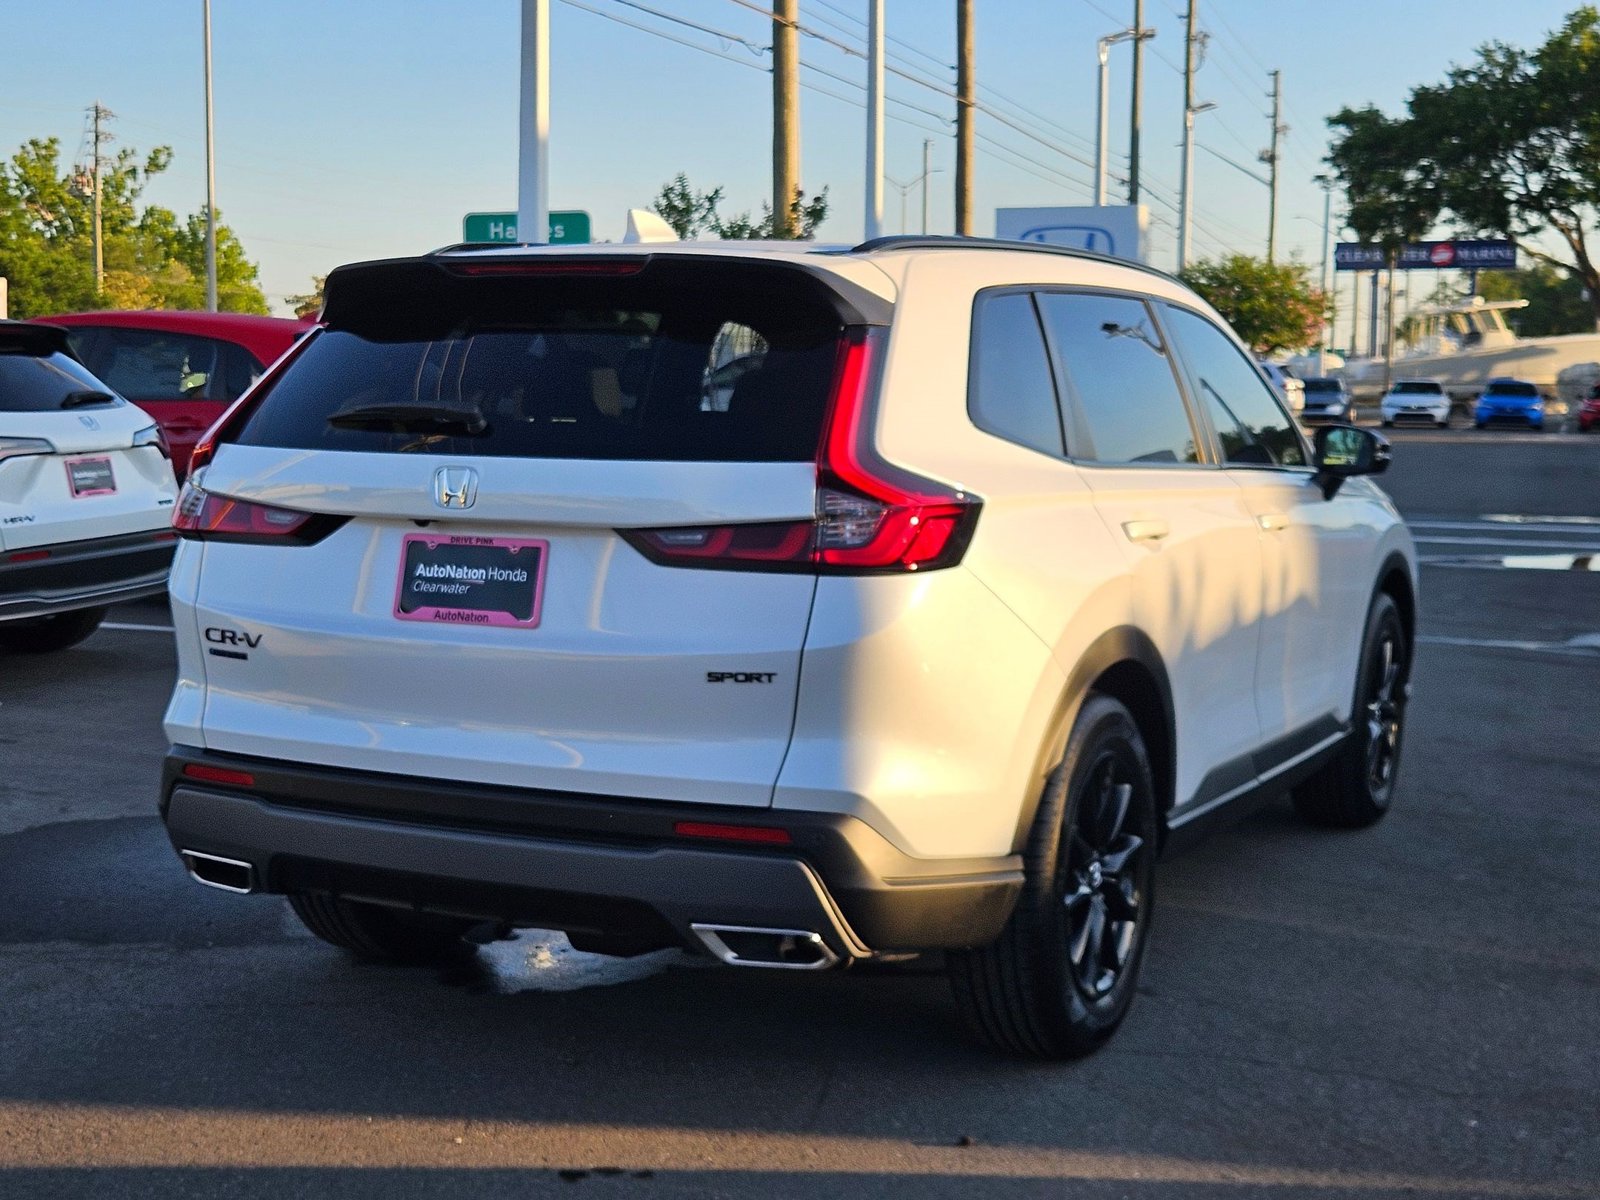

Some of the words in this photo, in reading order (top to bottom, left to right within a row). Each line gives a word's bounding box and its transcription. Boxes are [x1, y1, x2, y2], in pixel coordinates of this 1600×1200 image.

[1456, 246, 1514, 261] MARINE
[475, 537, 494, 545] PINK
[416, 563, 486, 580] AutoNation
[488, 566, 528, 582] Honda
[413, 580, 470, 595] Clearwater
[434, 610, 489, 623] AutoNation
[205, 627, 263, 649] CR-V
[707, 671, 778, 683] SPORT
